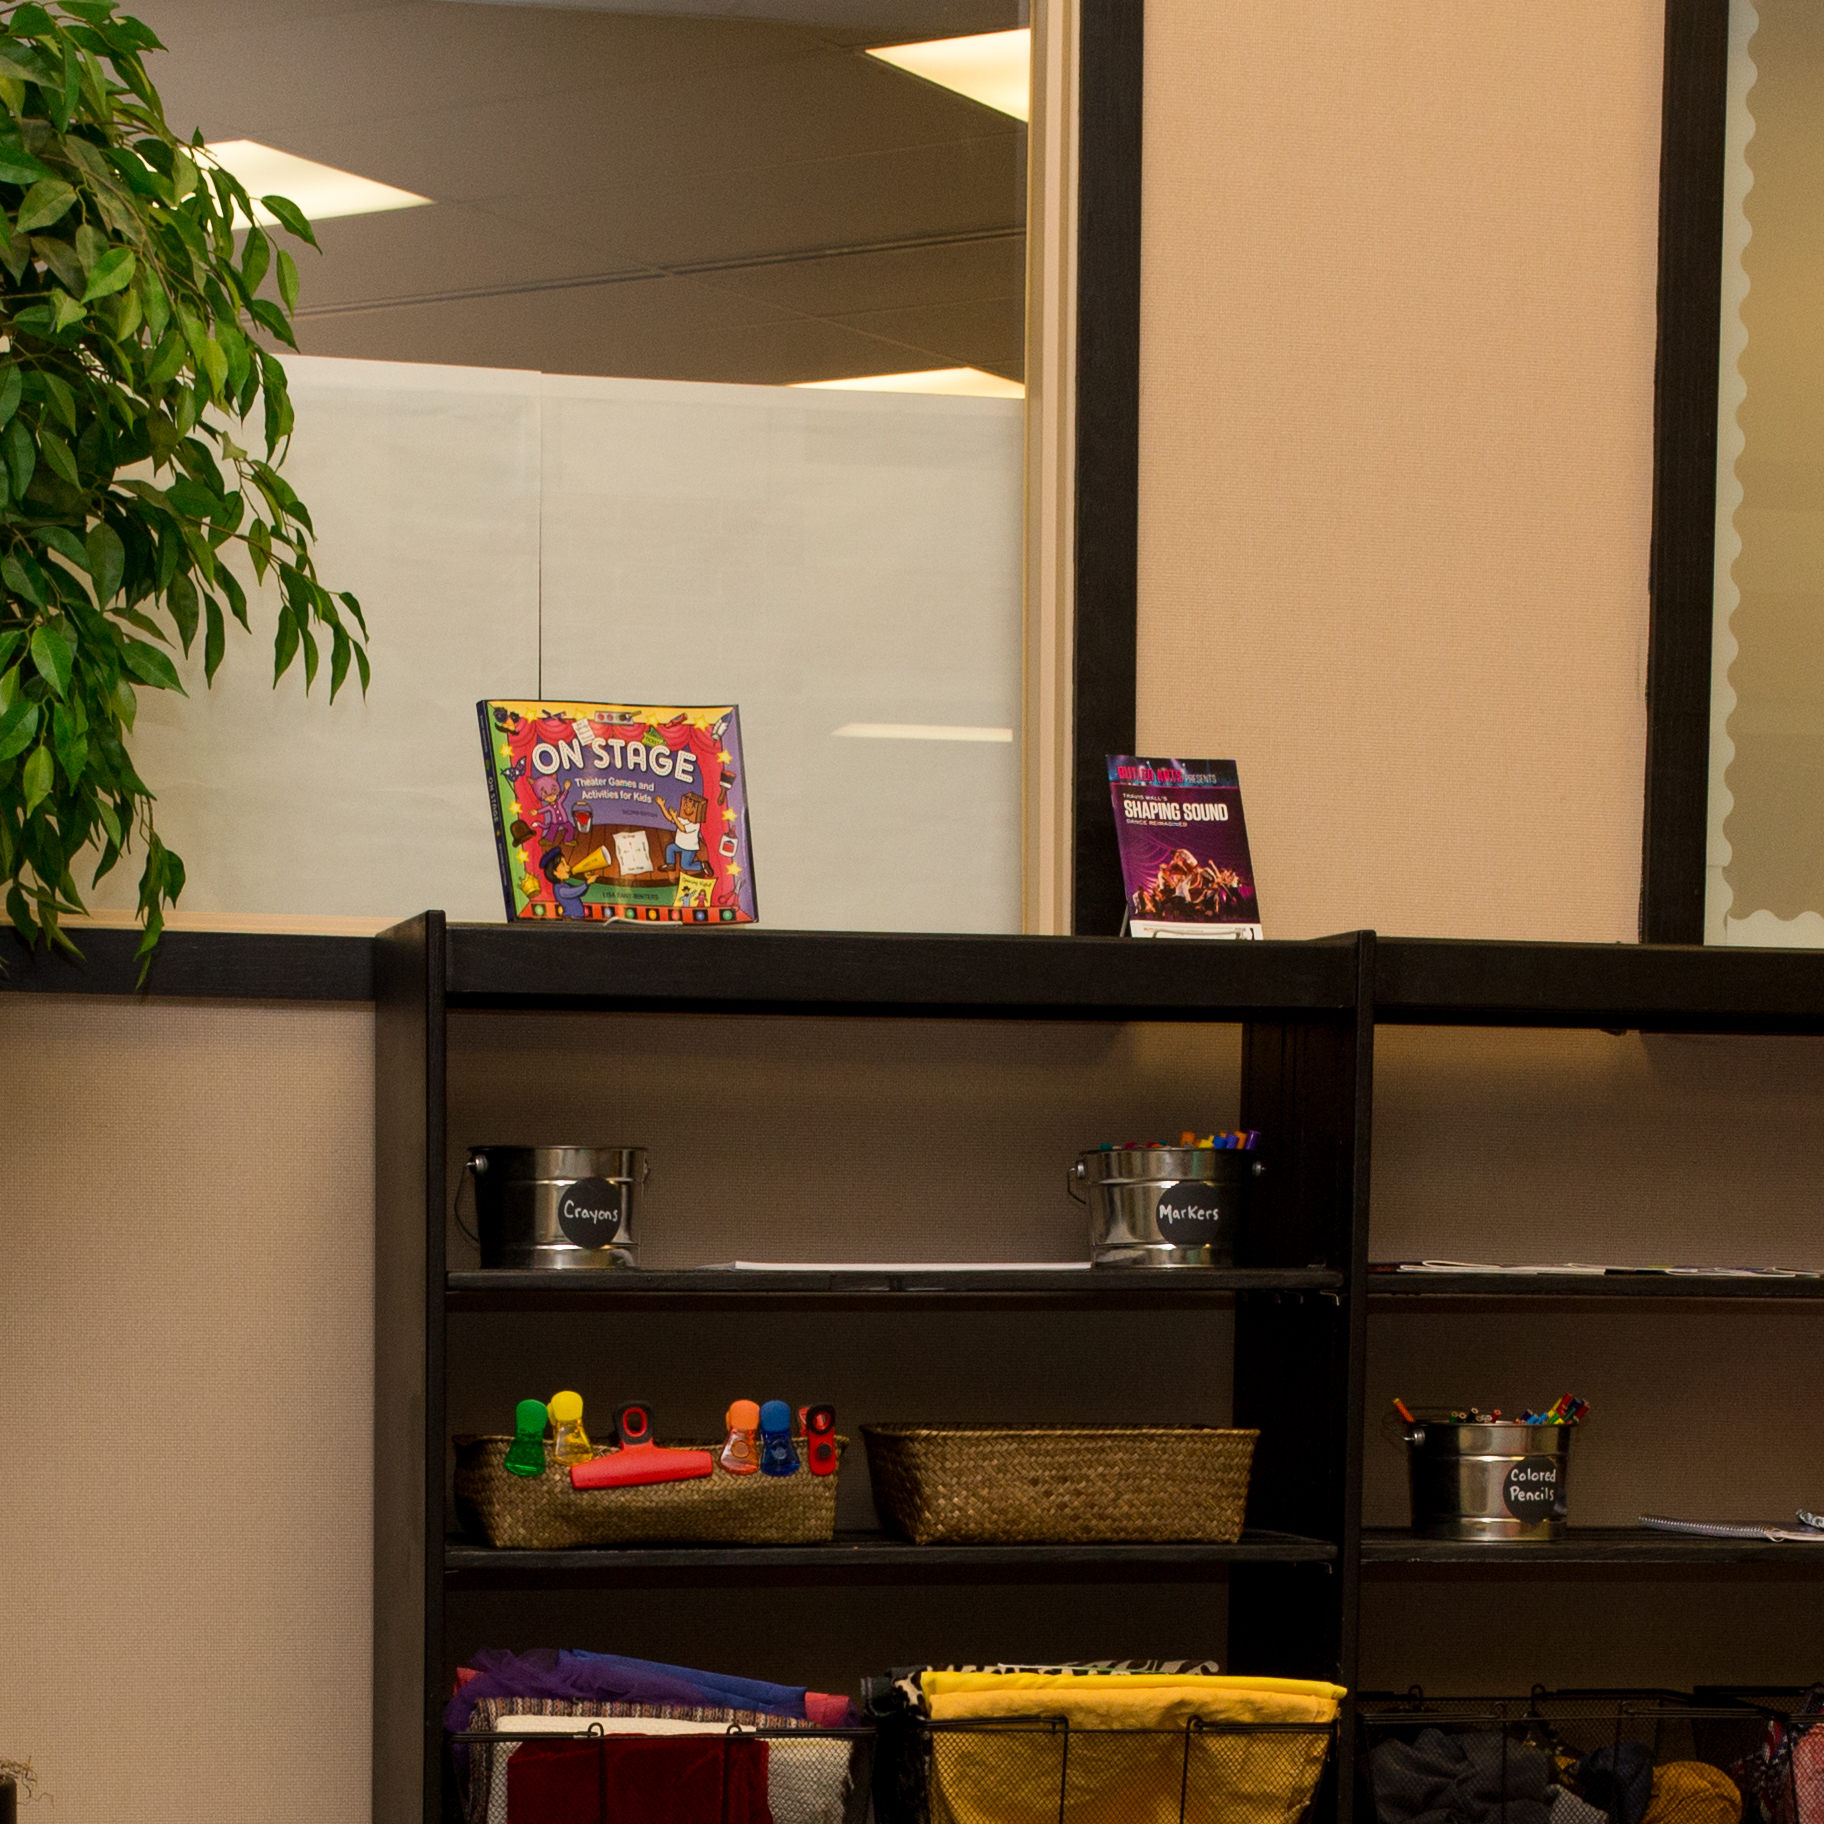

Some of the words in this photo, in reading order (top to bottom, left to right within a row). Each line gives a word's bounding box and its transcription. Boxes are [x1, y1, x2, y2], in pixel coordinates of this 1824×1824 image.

[532, 739, 585, 775] ON
[591, 737, 697, 784] STAGE
[487, 777, 495, 790] ON
[575, 777, 607, 788] Theater
[608, 778, 637, 789] Games
[638, 780, 654, 791] and
[1185, 774, 1217, 784] PRESENTS
[582, 790, 619, 800] Activities
[620, 790, 631, 800] for
[633, 793, 652, 803] Kids
[489, 790, 500, 823] STAGE
[1123, 800, 1181, 821] SHAPING
[1183, 803, 1228, 822] SOUND
[564, 1200, 618, 1224] Crayons
[1159, 1204, 1219, 1224] Markers
[1510, 1468, 1556, 1482] Colored
[1510, 1486, 1554, 1501] Pencils
